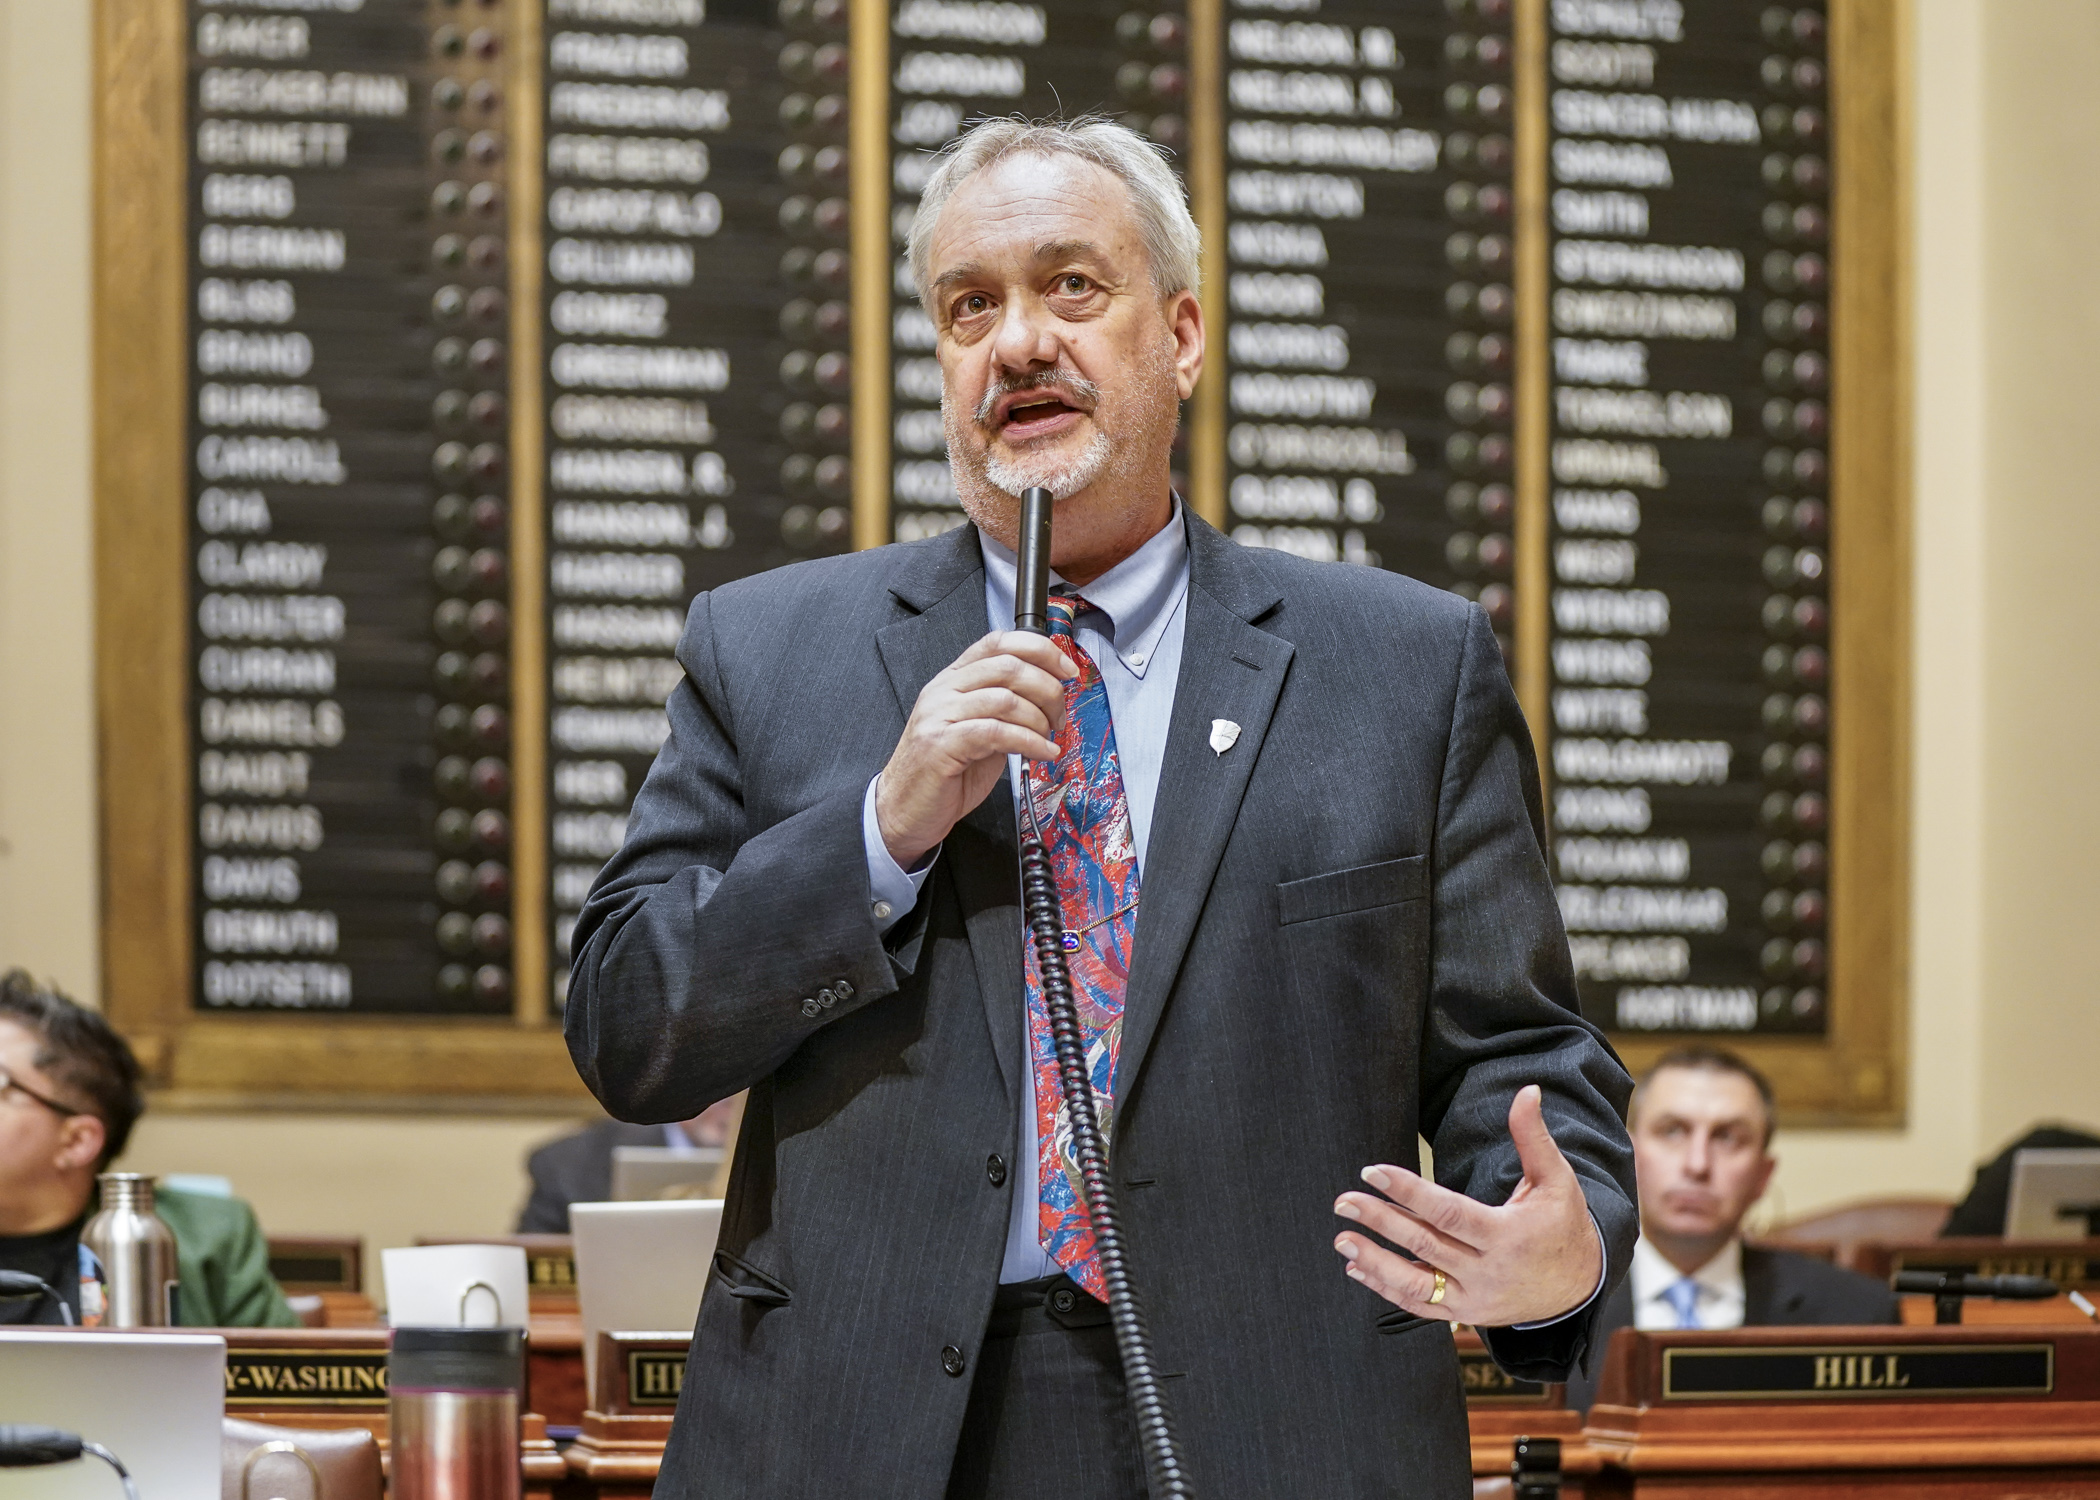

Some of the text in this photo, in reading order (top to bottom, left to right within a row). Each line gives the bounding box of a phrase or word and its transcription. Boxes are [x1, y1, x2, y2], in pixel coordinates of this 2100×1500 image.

[200, 16, 306, 56] BAKER
[553, 34, 686, 75] FRAZIER
[1556, 44, 1651, 80] SCOTT
[553, 84, 727, 128] FREDERICK
[201, 122, 345, 163] BENNETT
[551, 190, 719, 233] GAROFALO
[1231, 173, 1361, 215] NEWTON
[1555, 192, 1646, 231] SMITH
[1557, 242, 1742, 286] STEPHENSON
[1232, 275, 1321, 313] NOOR
[553, 294, 664, 335] GOMEZ
[201, 332, 310, 374] BRAND
[202, 386, 323, 427] BURKEL
[1233, 376, 1371, 415] NOVOTNY
[1559, 389, 1729, 433] TORKELSON
[201, 438, 341, 481] CARROLL
[202, 491, 267, 528] CHA
[202, 545, 322, 584] CLARDY
[1558, 543, 1633, 580] WEST
[203, 597, 342, 638] COULTER
[204, 650, 332, 687] CURRAN
[205, 702, 340, 741] DANIELS
[204, 755, 305, 791] DAUDT
[206, 810, 318, 843] DAVIDS
[208, 860, 295, 895] DAVIS
[208, 913, 334, 947] DEMUTH
[209, 965, 347, 1000] DOTSETH
[1620, 989, 1754, 1025] HORTMAN
[1815, 1356, 1909, 1388] HILL
